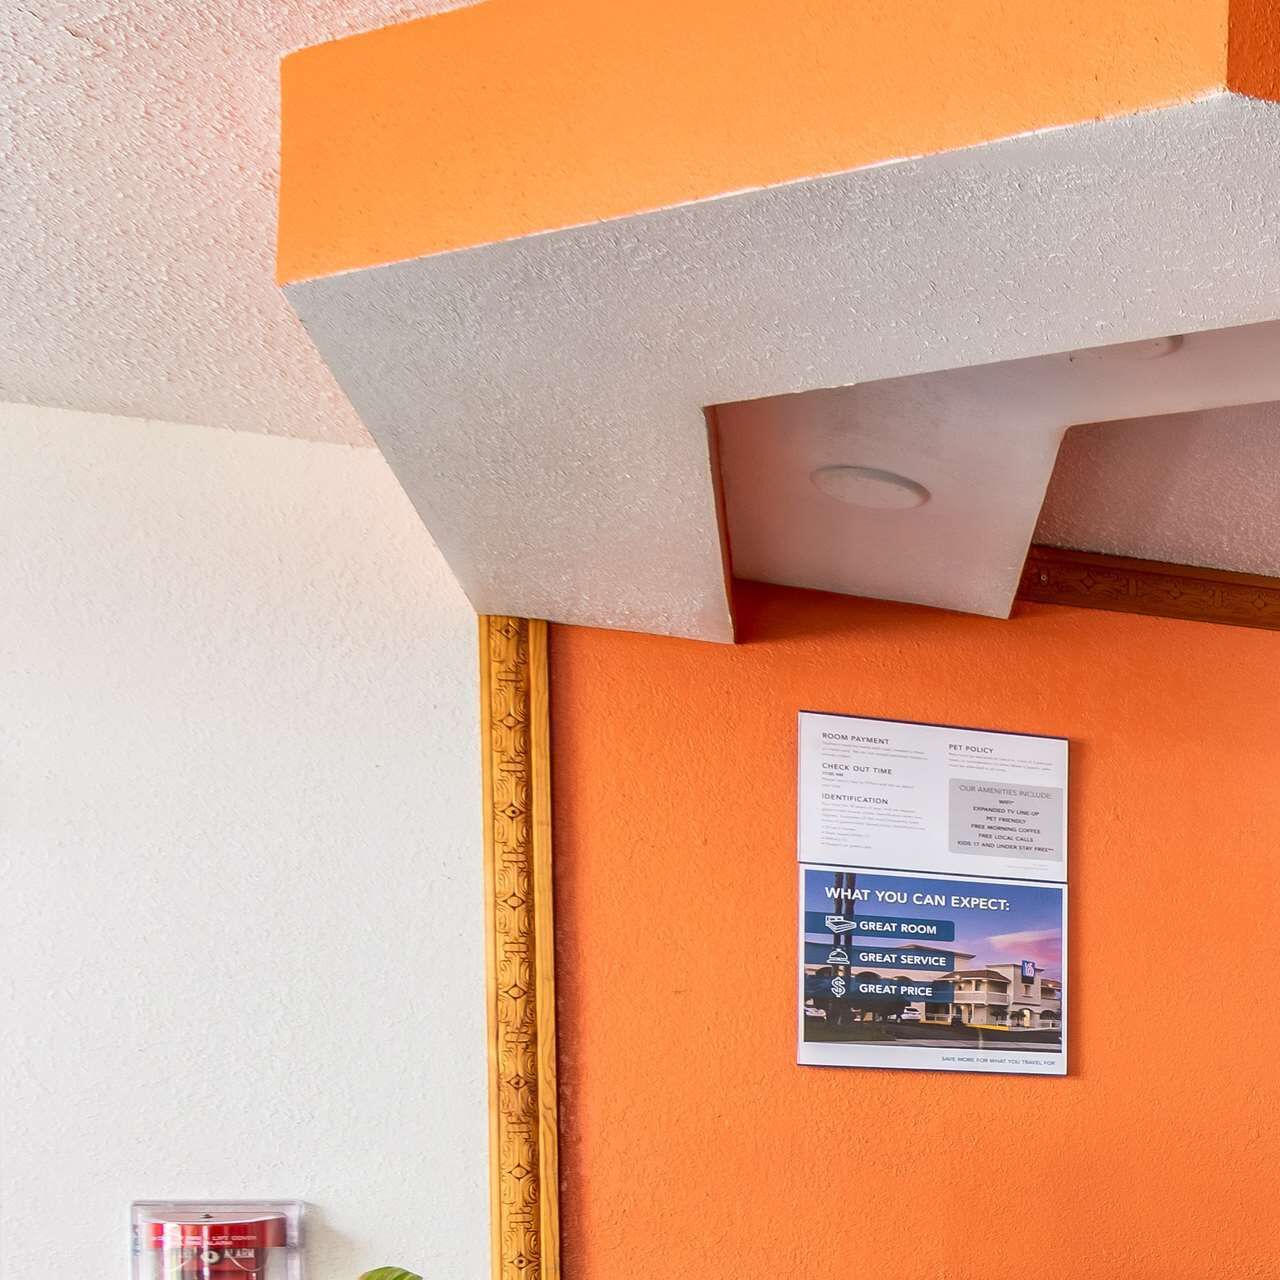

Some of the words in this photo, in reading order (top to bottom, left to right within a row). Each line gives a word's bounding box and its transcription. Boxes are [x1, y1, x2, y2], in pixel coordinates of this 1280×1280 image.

[822, 732, 848, 741] ROOM
[851, 735, 889, 745] PAYMENT
[948, 743, 962, 751] PET
[965, 745, 994, 754] POLICY
[822, 762, 849, 771] CHECK
[853, 765, 870, 773] OUT
[873, 767, 892, 775] TIME
[959, 784, 976, 792] OUR
[977, 786, 1017, 797] AMENITIES
[822, 793, 888, 805] IDENTIFICATION
[973, 806, 1006, 814] EXPANDED
[987, 825, 1017, 833] MORNING
[825, 886, 870, 901] WHAT
[875, 890, 908, 904] YOU
[912, 893, 946, 906] CAN
[951, 896, 1010, 912] EXPECT:
[859, 920, 897, 932] GREAT
[900, 922, 937, 936] ROOM
[859, 952, 897, 964] GREAT
[900, 954, 946, 967] SERVICE
[859, 983, 897, 995] GREAT
[900, 985, 933, 997] PRICE
